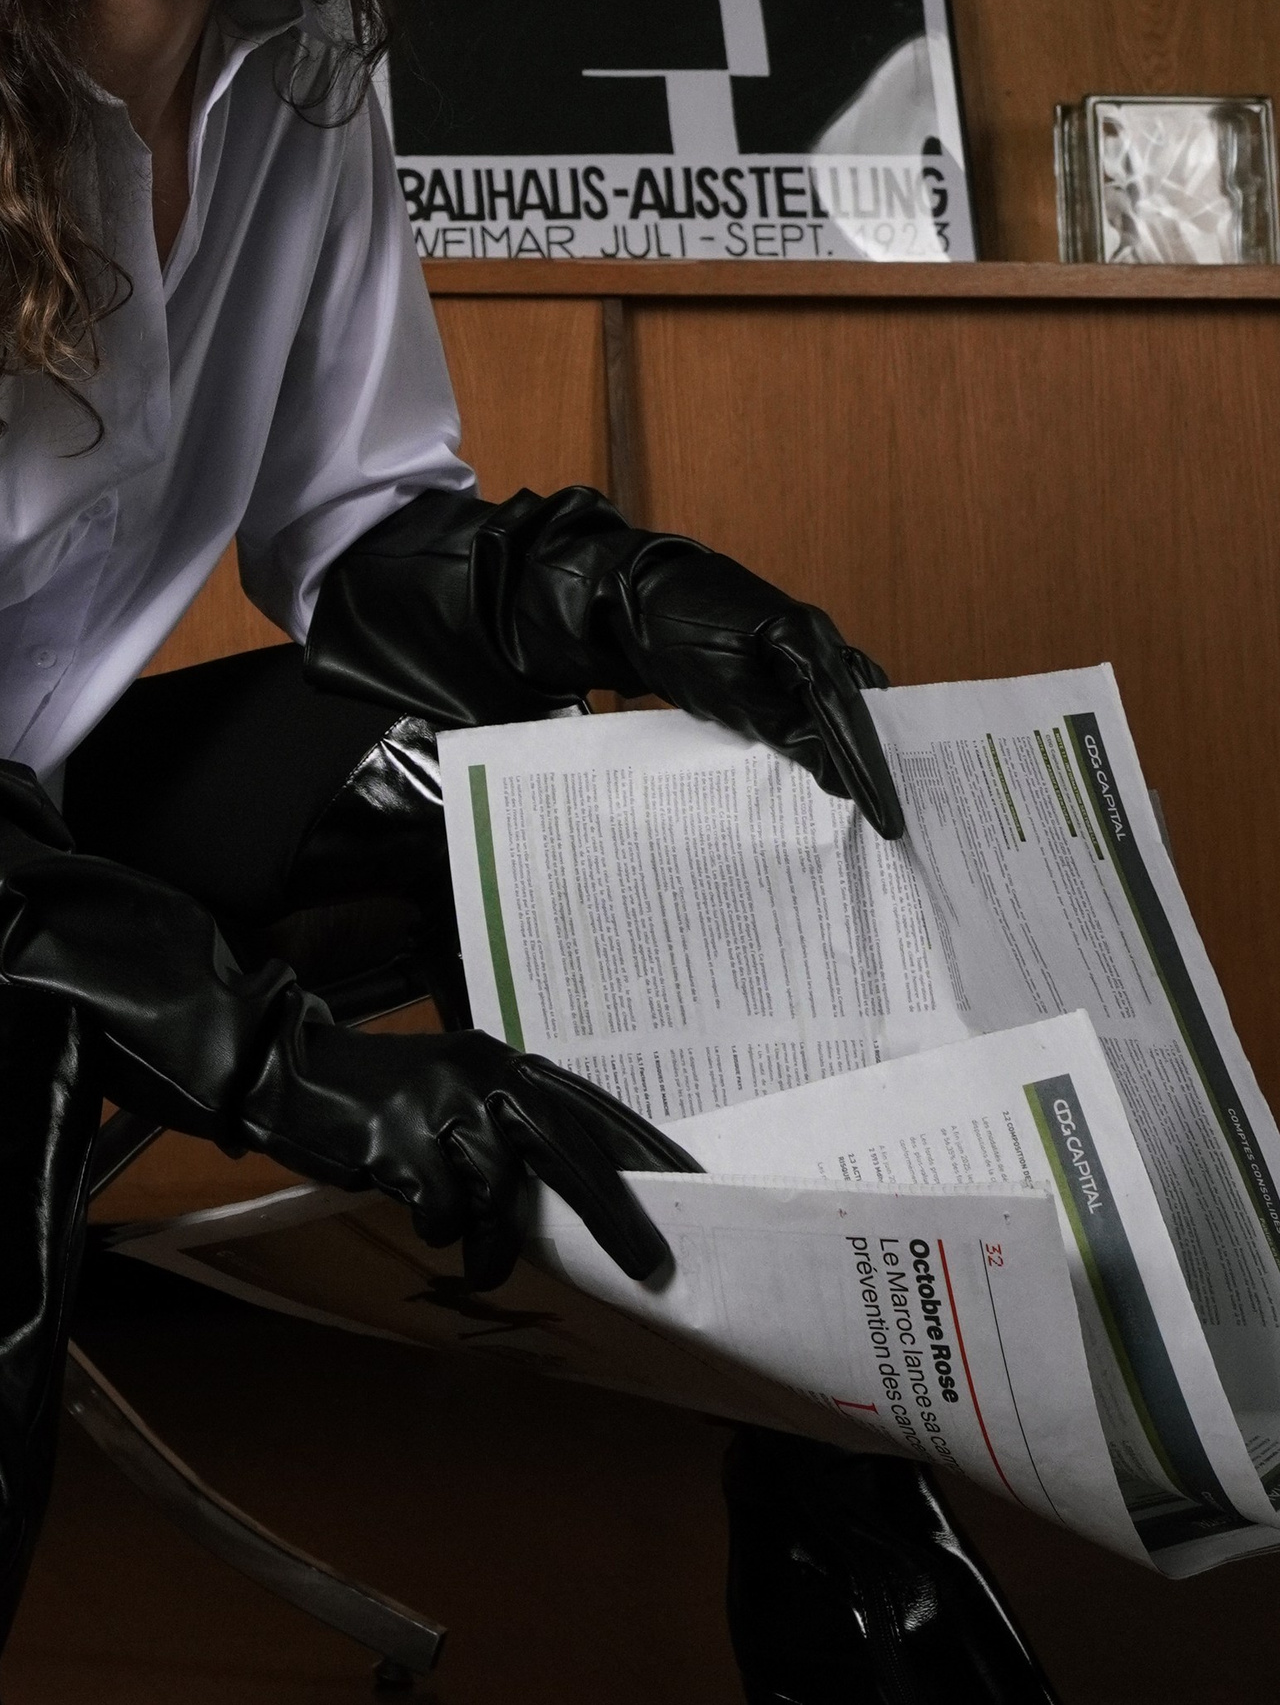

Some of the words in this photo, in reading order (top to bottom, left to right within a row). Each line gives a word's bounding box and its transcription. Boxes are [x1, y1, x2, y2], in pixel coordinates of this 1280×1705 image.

[415, 225, 577, 259] WEIMAR
[1084, 734, 1102, 769] CDG
[1095, 769, 1126, 842] CAPITAL
[635, 1051, 644, 1066] 1.5.1
[643, 1092, 650, 1100] de
[654, 1059, 664, 1084] RISQUES
[658, 1083, 666, 1092] DE
[952, 1130, 960, 1141] fin
[1001, 1110, 1012, 1122] 2.2
[1227, 1107, 1255, 1161] COMPTES
[847, 1152, 857, 1164] 2.3
[970, 1118, 989, 1159] dispositions
[984, 1158, 992, 1168] de
[980, 1115, 990, 1130] Les
[996, 1162, 1005, 1173] de
[1006, 1121, 1028, 1170] COMPOSITION
[1052, 1098, 1076, 1136] CDG
[1065, 1135, 1103, 1215] CAPITAL
[837, 1155, 852, 1181] RISQUE
[879, 1237, 899, 1267] Le
[984, 1242, 1004, 1267] 32
[844, 1236, 891, 1359] prévention
[877, 1362, 902, 1401] des
[885, 1270, 916, 1346] Maroc
[908, 1238, 944, 1341] Octobre
[929, 1343, 959, 1404] Rose
[902, 1349, 932, 1408] lance
[919, 1410, 941, 1434] sa
